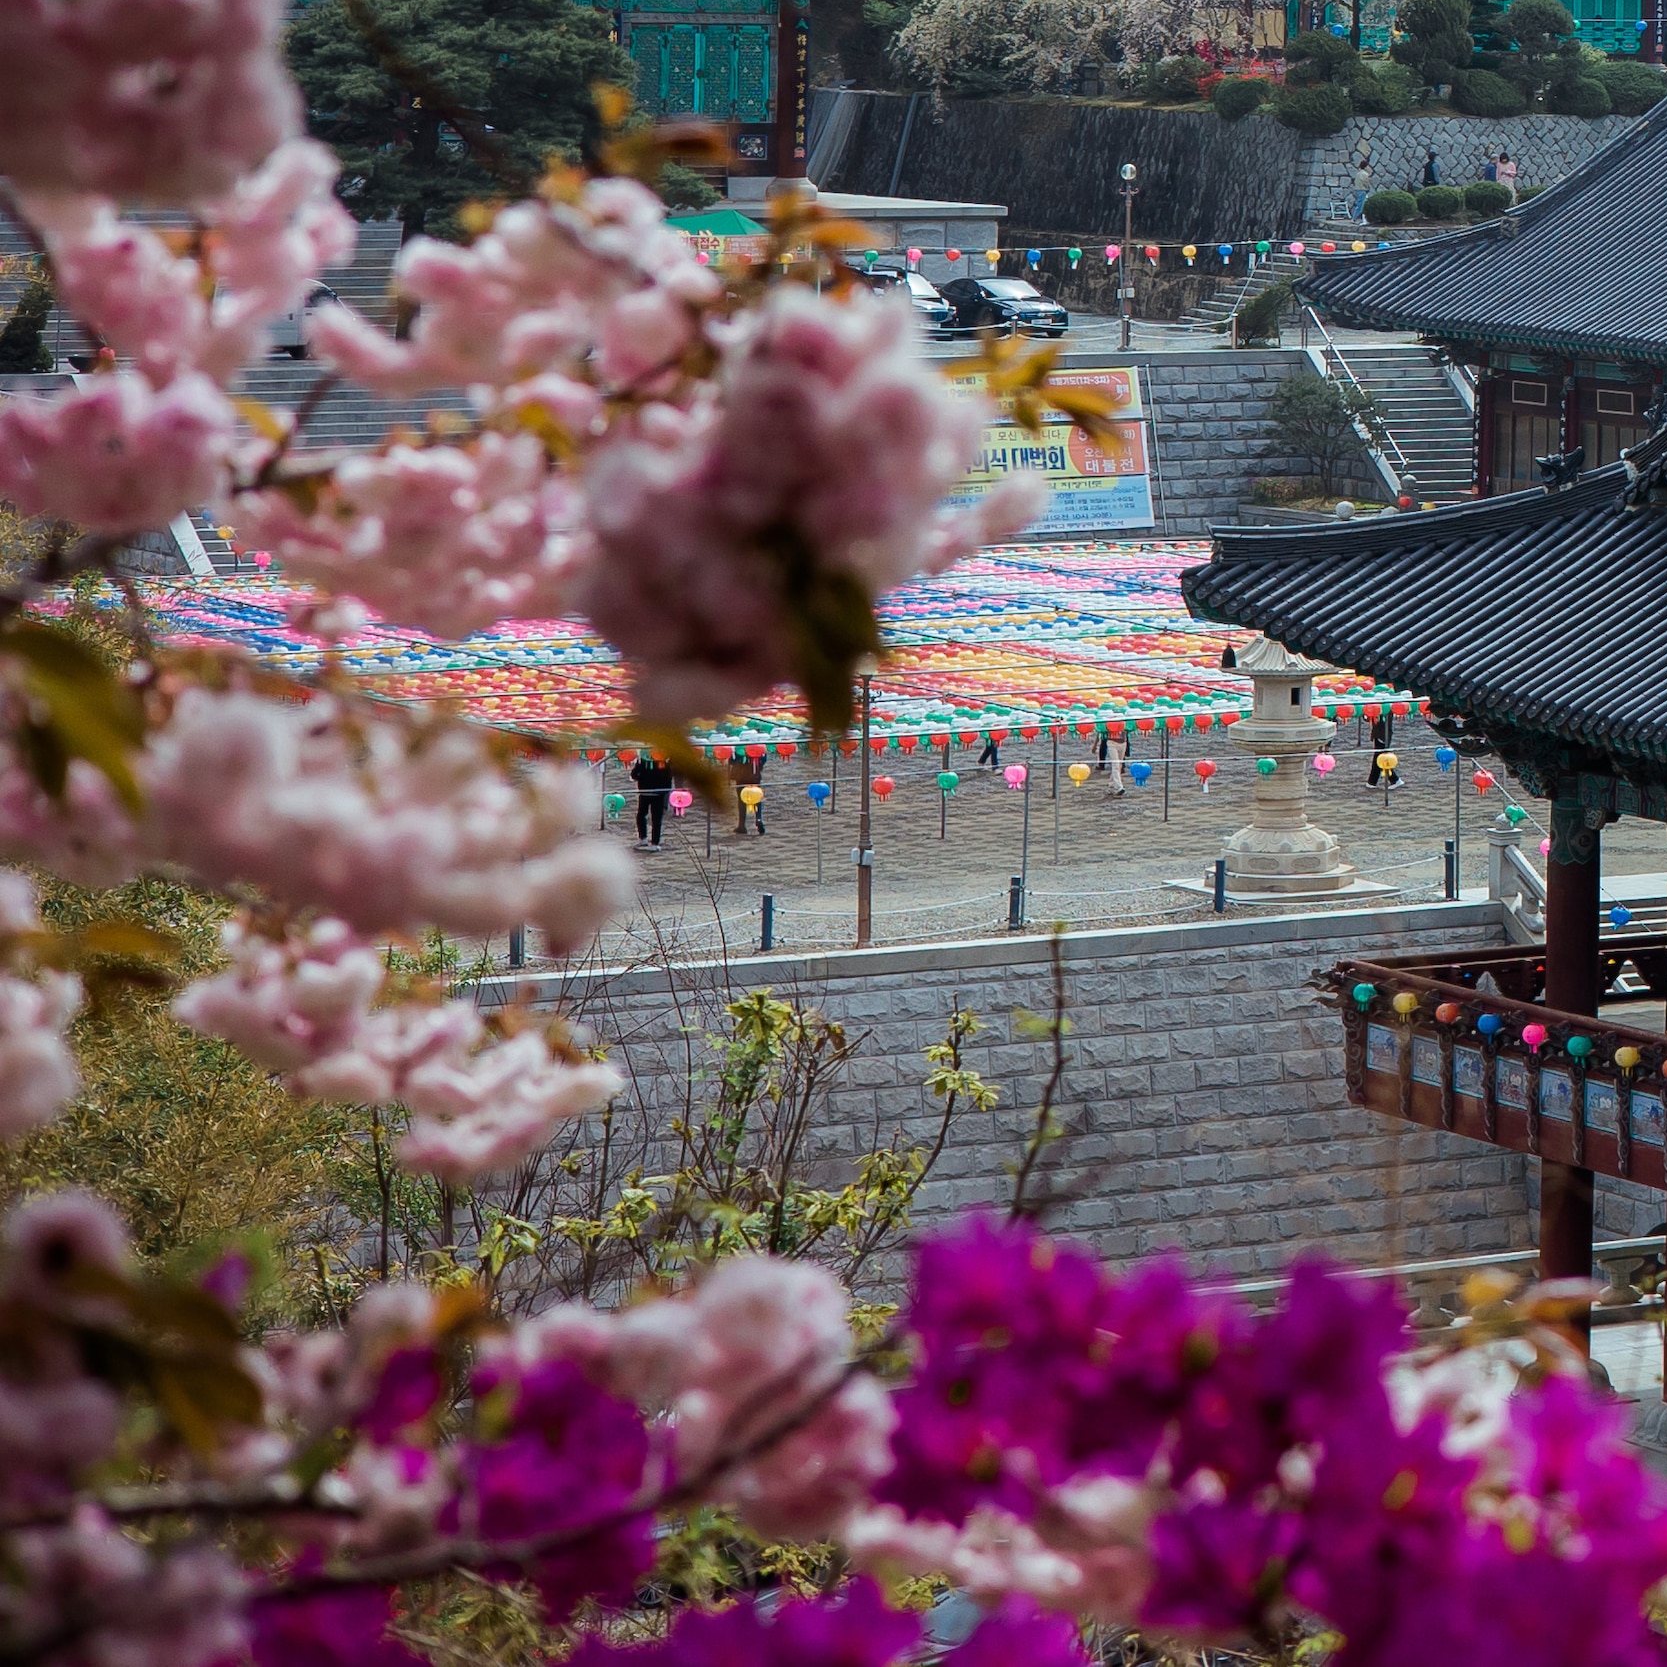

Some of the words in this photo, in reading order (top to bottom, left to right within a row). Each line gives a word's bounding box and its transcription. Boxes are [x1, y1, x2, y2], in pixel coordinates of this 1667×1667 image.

[998, 431, 1017, 441] 모신
[965, 448, 1008, 474] 의식
[1011, 445, 1066, 472] 대법회
